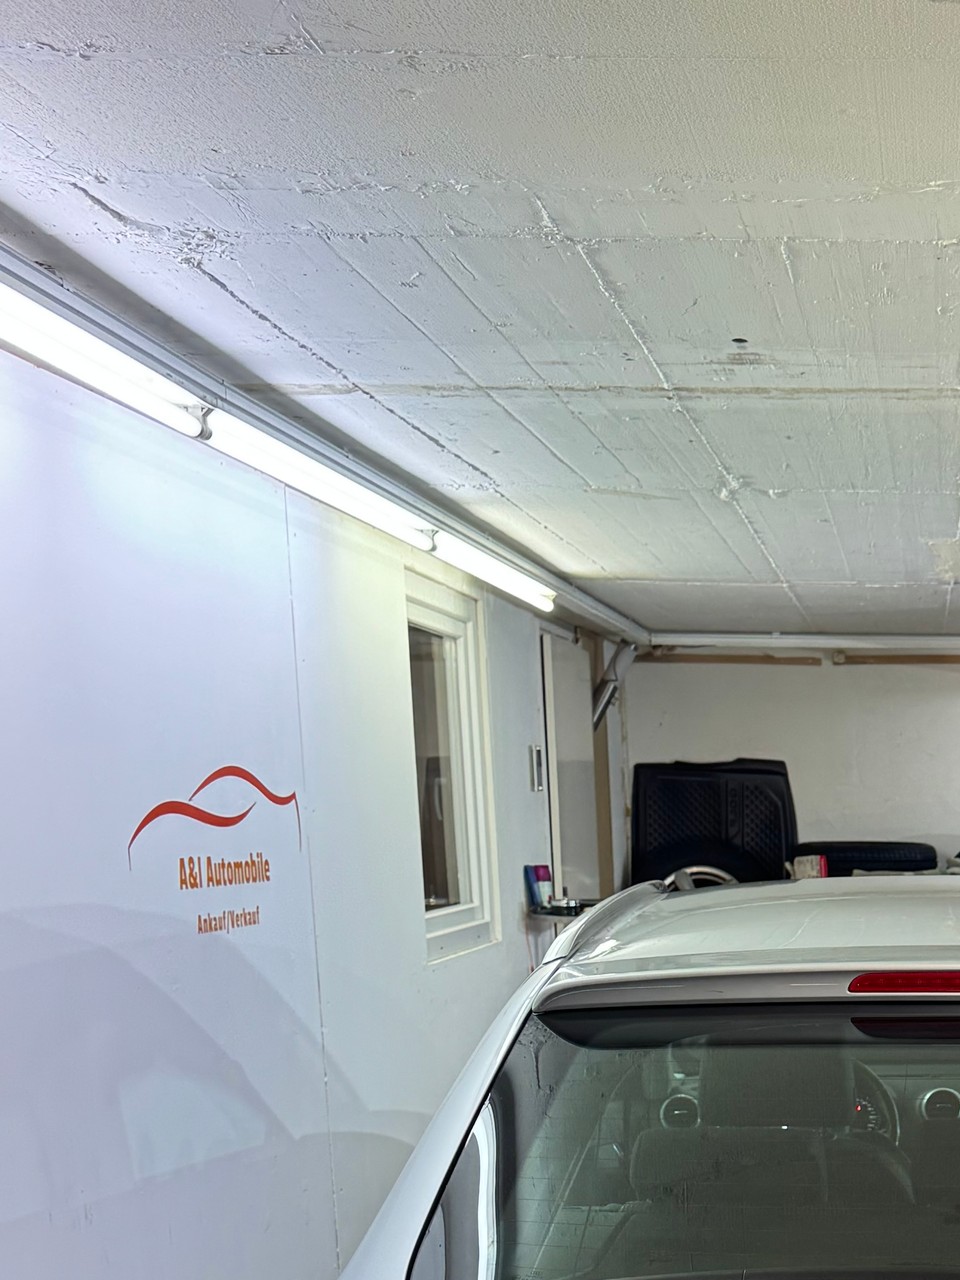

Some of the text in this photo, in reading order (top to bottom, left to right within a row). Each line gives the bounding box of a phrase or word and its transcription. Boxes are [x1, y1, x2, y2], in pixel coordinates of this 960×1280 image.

[178, 852, 270, 891] A&I Automobile
[197, 905, 259, 934] Ankauf/Verkauf
